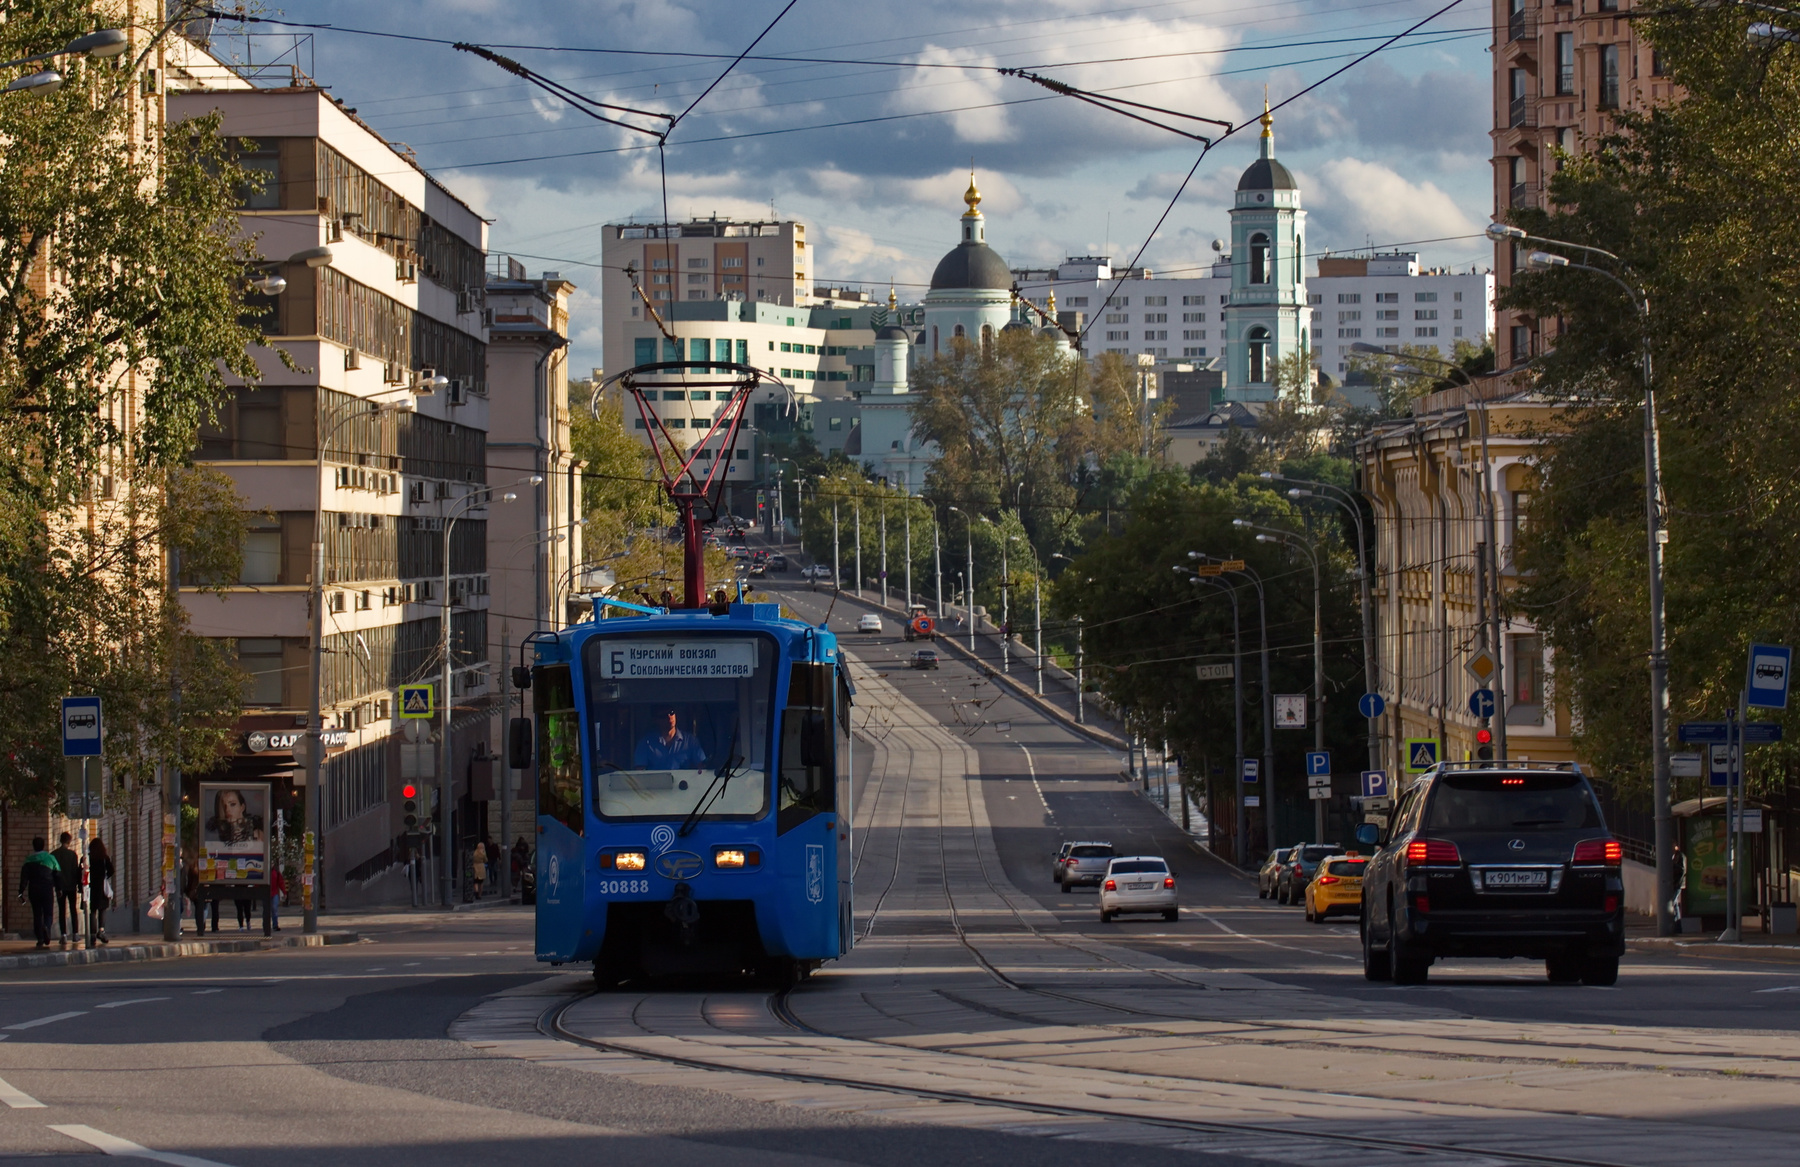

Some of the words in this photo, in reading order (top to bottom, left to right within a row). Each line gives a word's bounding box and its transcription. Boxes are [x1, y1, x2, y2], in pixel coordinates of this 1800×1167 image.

[610, 651, 625, 675] Б
[1200, 665, 1228, 677] СТОП
[1312, 755, 1326, 771] P
[1368, 773, 1383, 795] P
[600, 880, 649, 894] 30888
